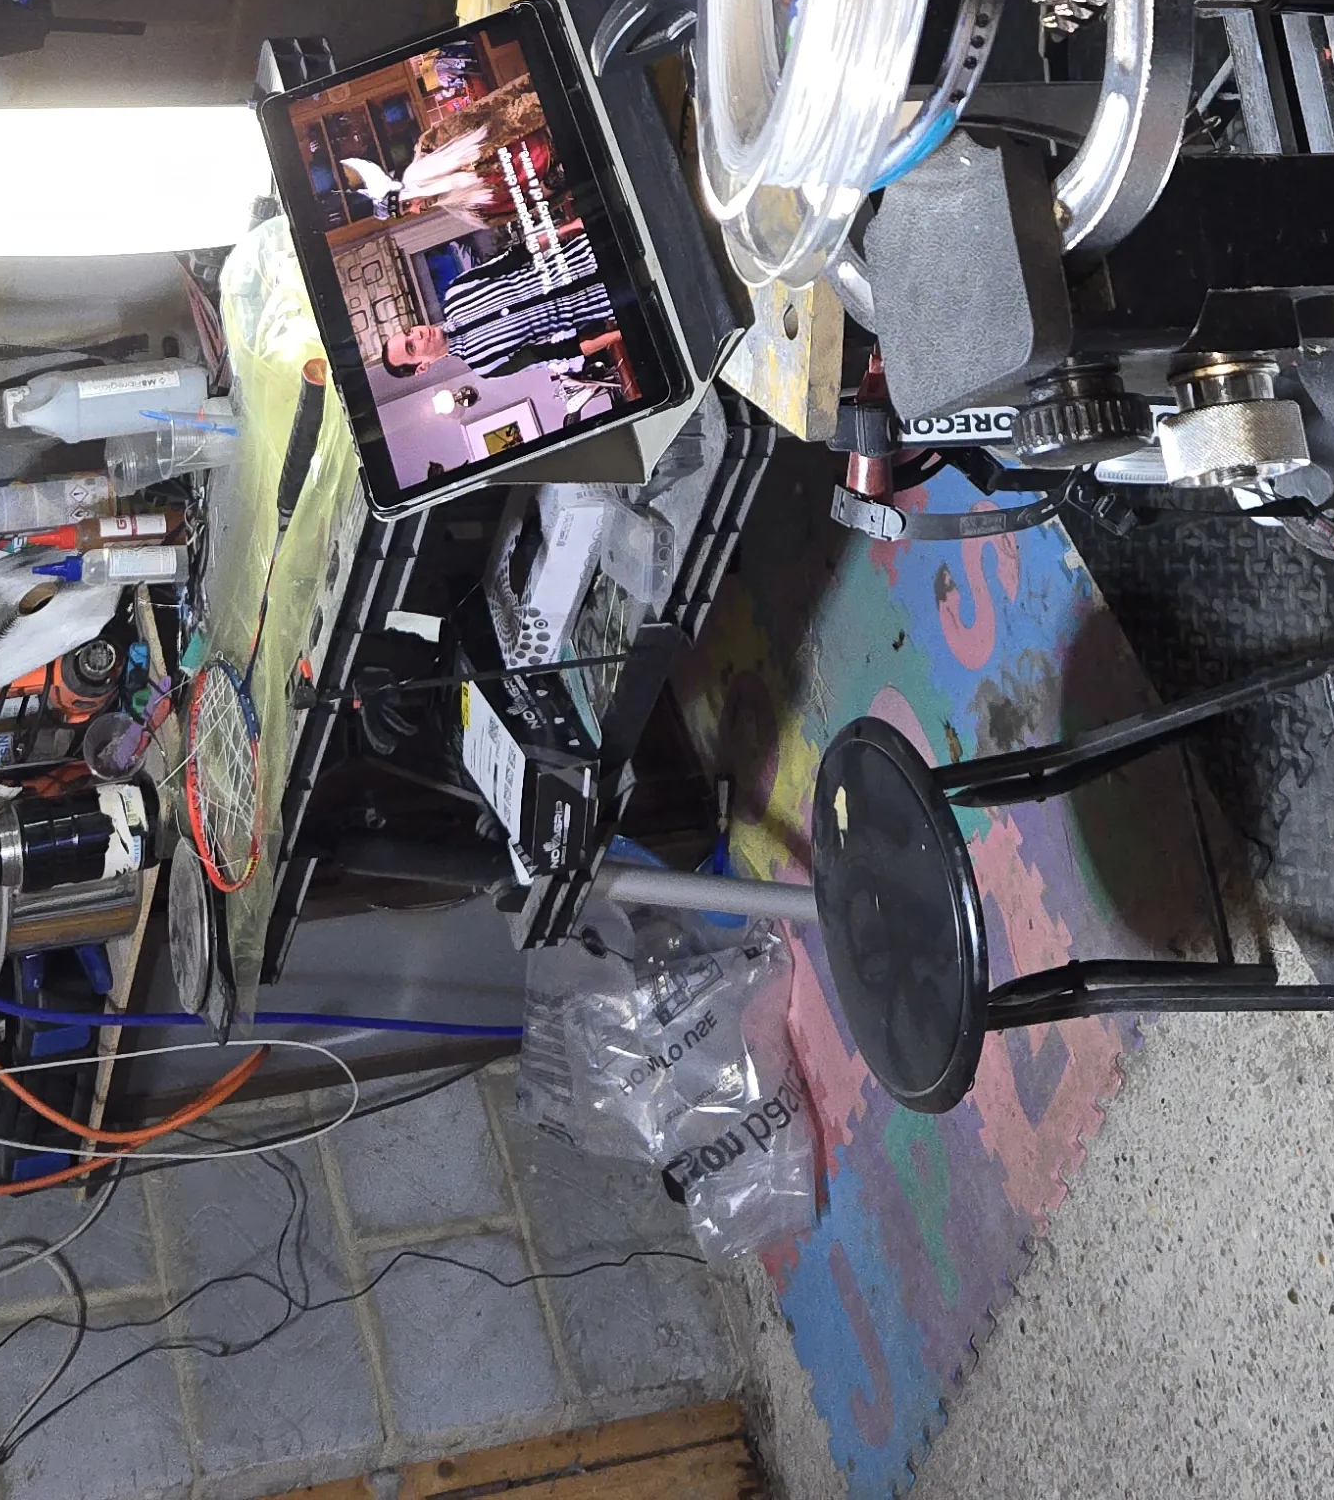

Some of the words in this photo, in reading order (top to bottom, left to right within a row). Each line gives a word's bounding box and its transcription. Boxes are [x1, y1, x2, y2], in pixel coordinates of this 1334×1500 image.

[497, 145, 517, 185] change
[529, 177, 540, 188] a
[528, 186, 544, 199] of
